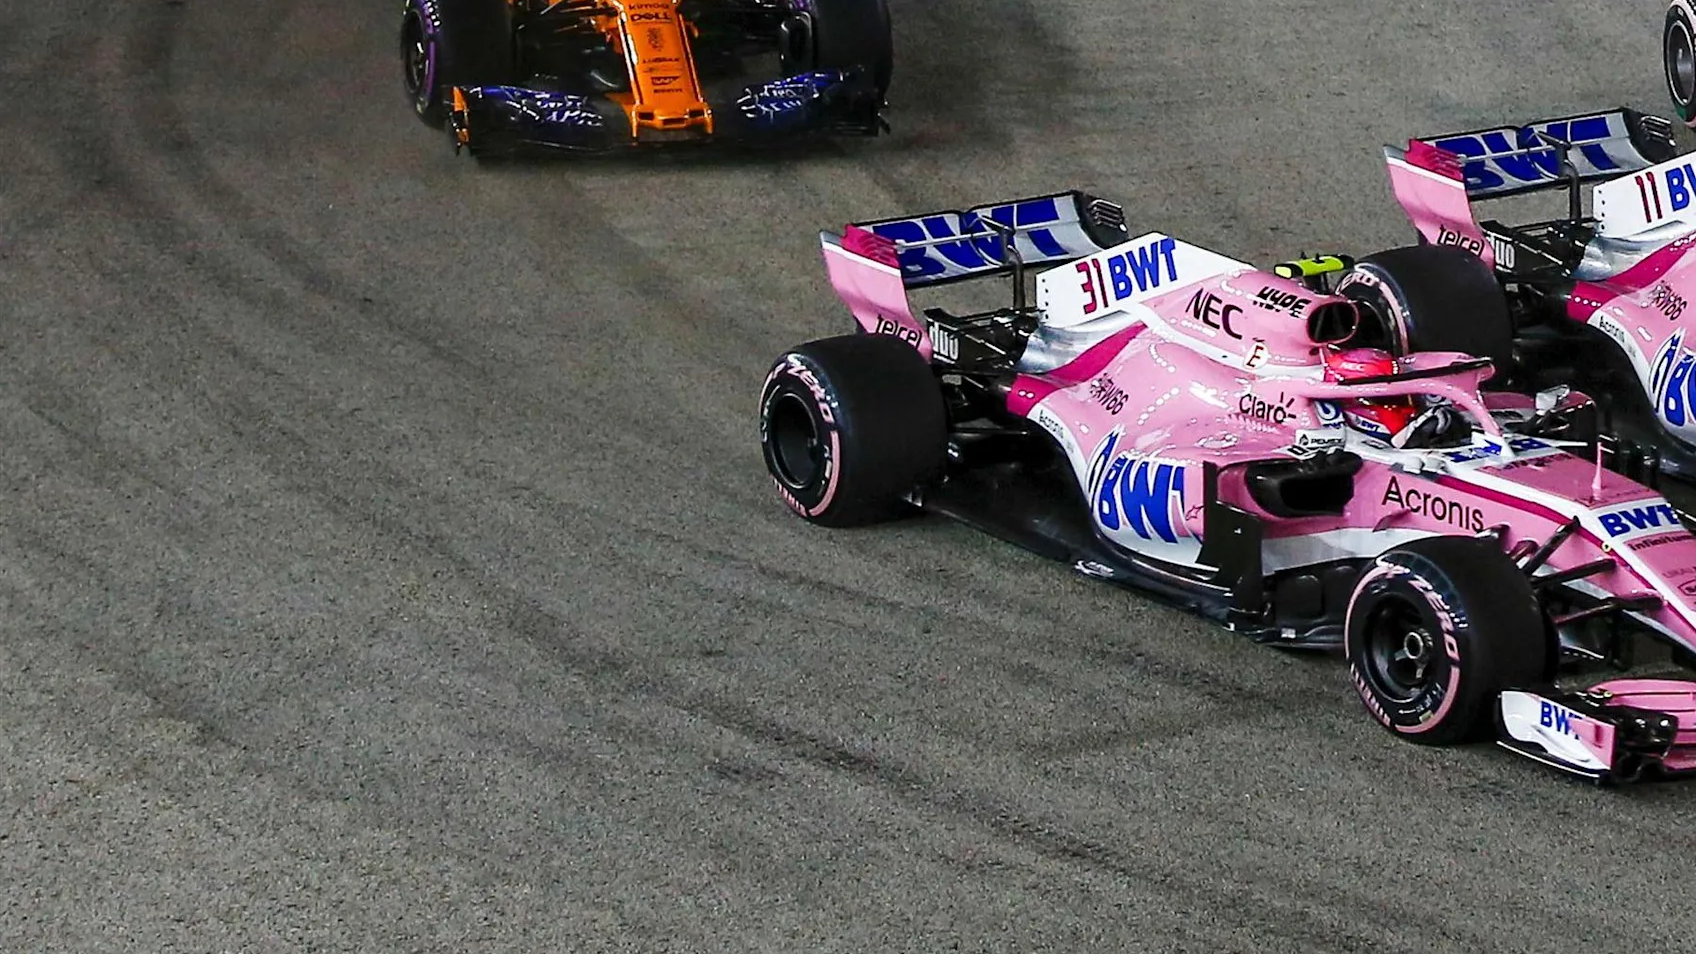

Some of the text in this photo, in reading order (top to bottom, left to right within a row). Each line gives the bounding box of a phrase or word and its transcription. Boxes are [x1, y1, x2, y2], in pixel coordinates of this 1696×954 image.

[1634, 172, 1663, 223] 11
[1075, 237, 1178, 315] 31 BWT
[876, 313, 922, 351] telcel
[1185, 289, 1244, 341] NEC
[1239, 394, 1287, 424] Claro
[1099, 456, 1203, 546] BWT
[1382, 474, 1484, 534] Acronis
[1599, 504, 1681, 538] BWT
[1627, 533, 1696, 551] infinitum
